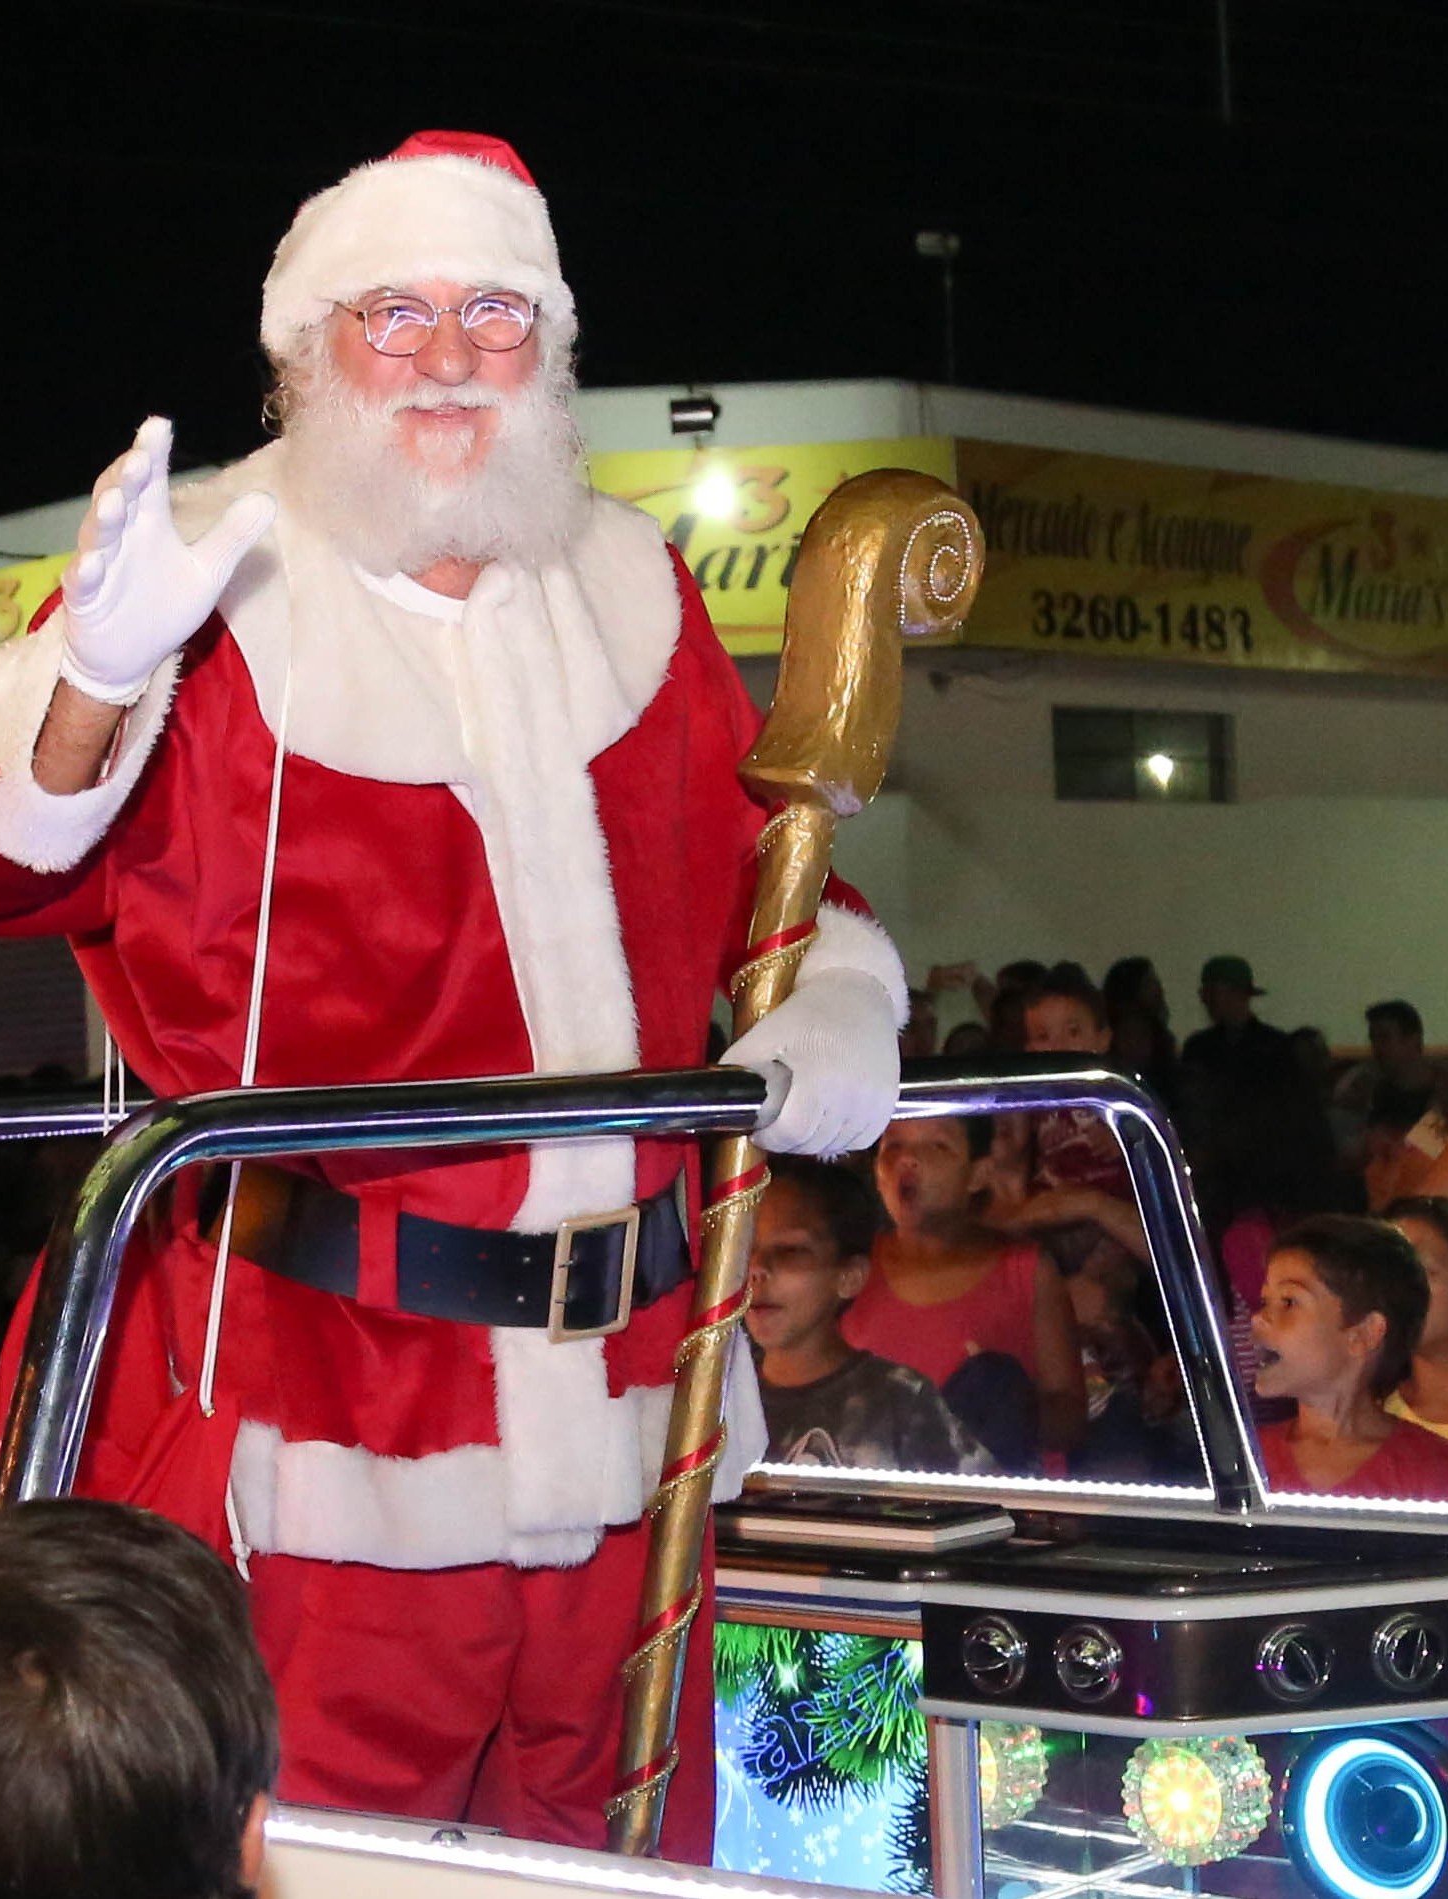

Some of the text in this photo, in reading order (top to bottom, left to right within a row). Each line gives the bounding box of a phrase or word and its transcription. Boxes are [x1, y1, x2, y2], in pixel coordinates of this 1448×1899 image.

[730, 466, 791, 534] 3
[970, 481, 1095, 560] Mercado
[1108, 508, 1127, 564] e
[1370, 510, 1397, 572] 3
